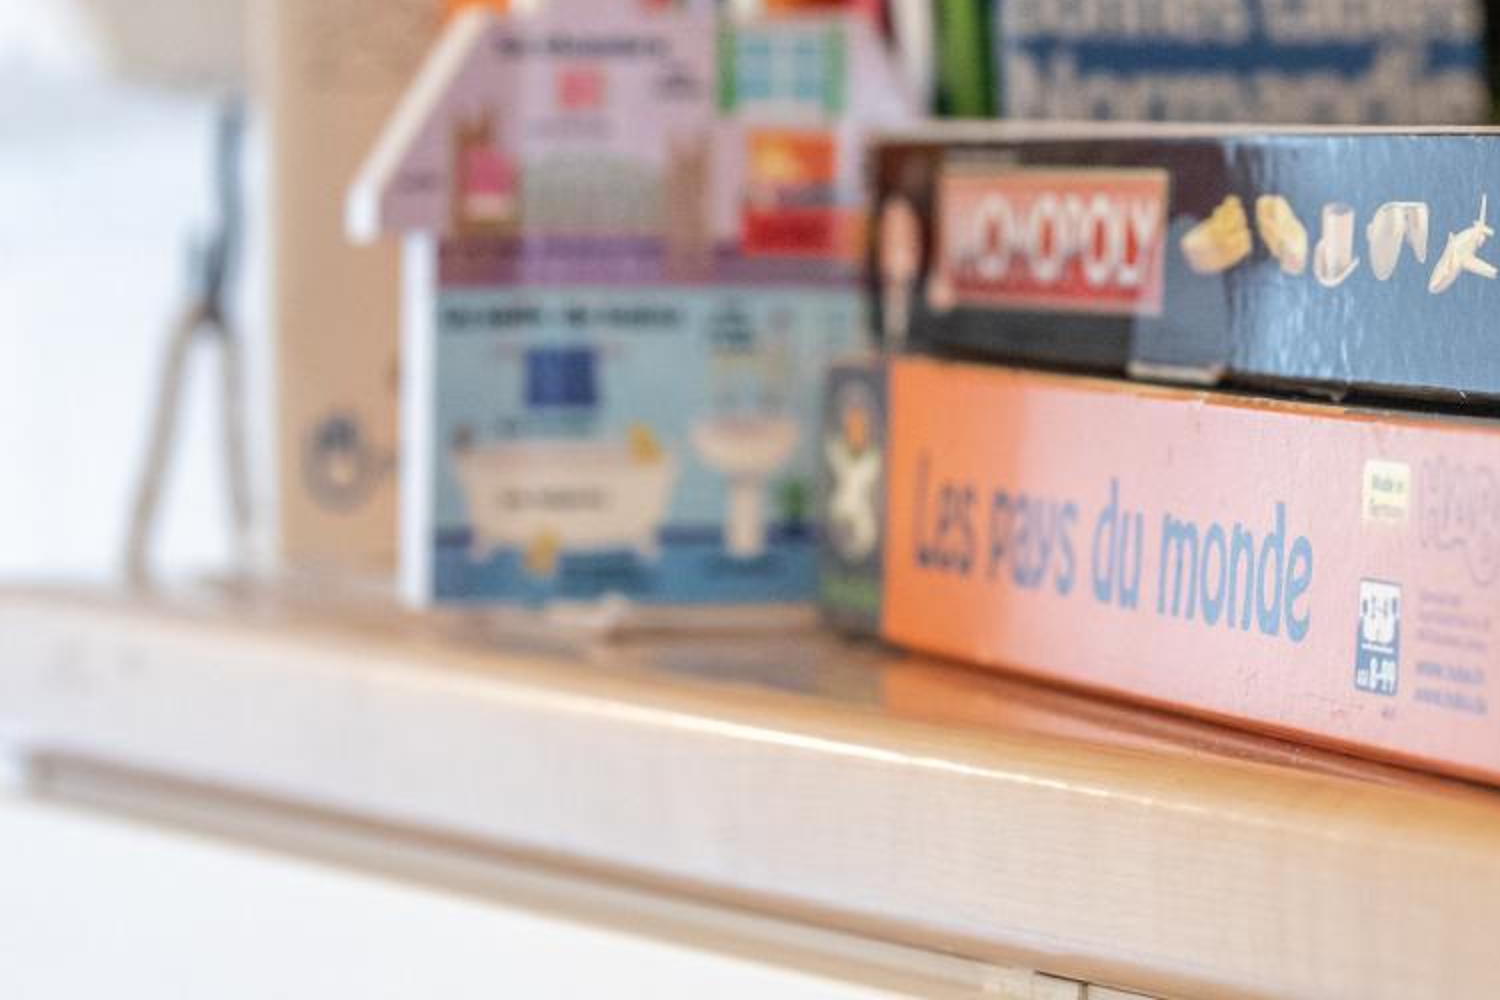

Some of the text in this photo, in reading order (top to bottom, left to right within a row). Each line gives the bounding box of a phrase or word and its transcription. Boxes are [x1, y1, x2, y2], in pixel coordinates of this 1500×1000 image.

[912, 446, 977, 576] Les
[984, 485, 1079, 596] pays
[1091, 476, 1145, 610] du
[1155, 502, 1314, 643] monde
